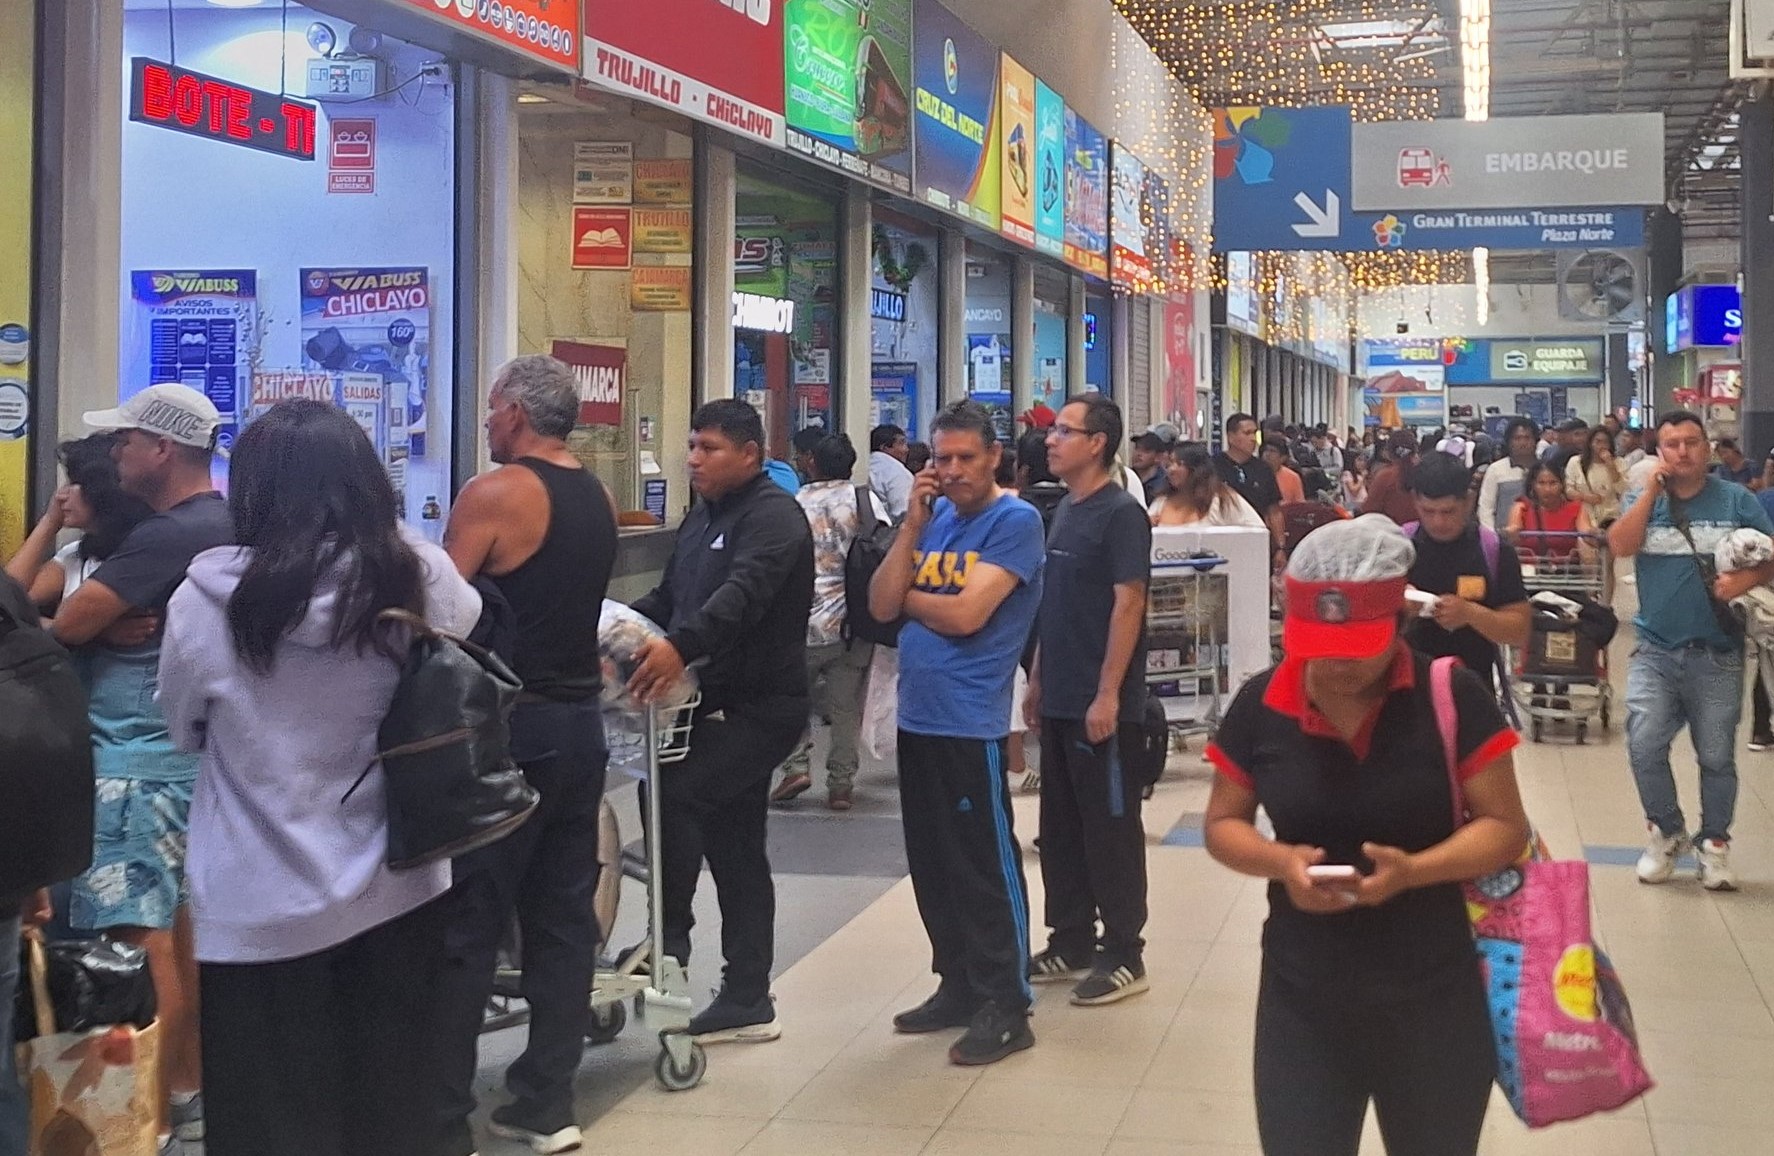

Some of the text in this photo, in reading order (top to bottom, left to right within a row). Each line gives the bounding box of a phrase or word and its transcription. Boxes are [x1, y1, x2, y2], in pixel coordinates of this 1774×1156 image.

[597, 47, 681, 104] TRUJILLO
[144, 65, 252, 139] BOTE
[916, 87, 941, 120] CRUZ
[1485, 148, 1628, 173] EMBARQUE
[1413, 211, 1614, 228] GRAN TERMINAL TERRESTRE
[1541, 228, 1614, 242] Plaza Norte
[330, 271, 422, 291] VIABUSS
[174, 300, 214, 308] AVISOS
[327, 287, 427, 315] CHICLAYO
[1535, 348, 1585, 359] GUARDA
[1532, 360, 1588, 372] EQUIPAJE
[344, 386, 381, 400] SALIDAS
[140, 400, 199, 440] NIKE
